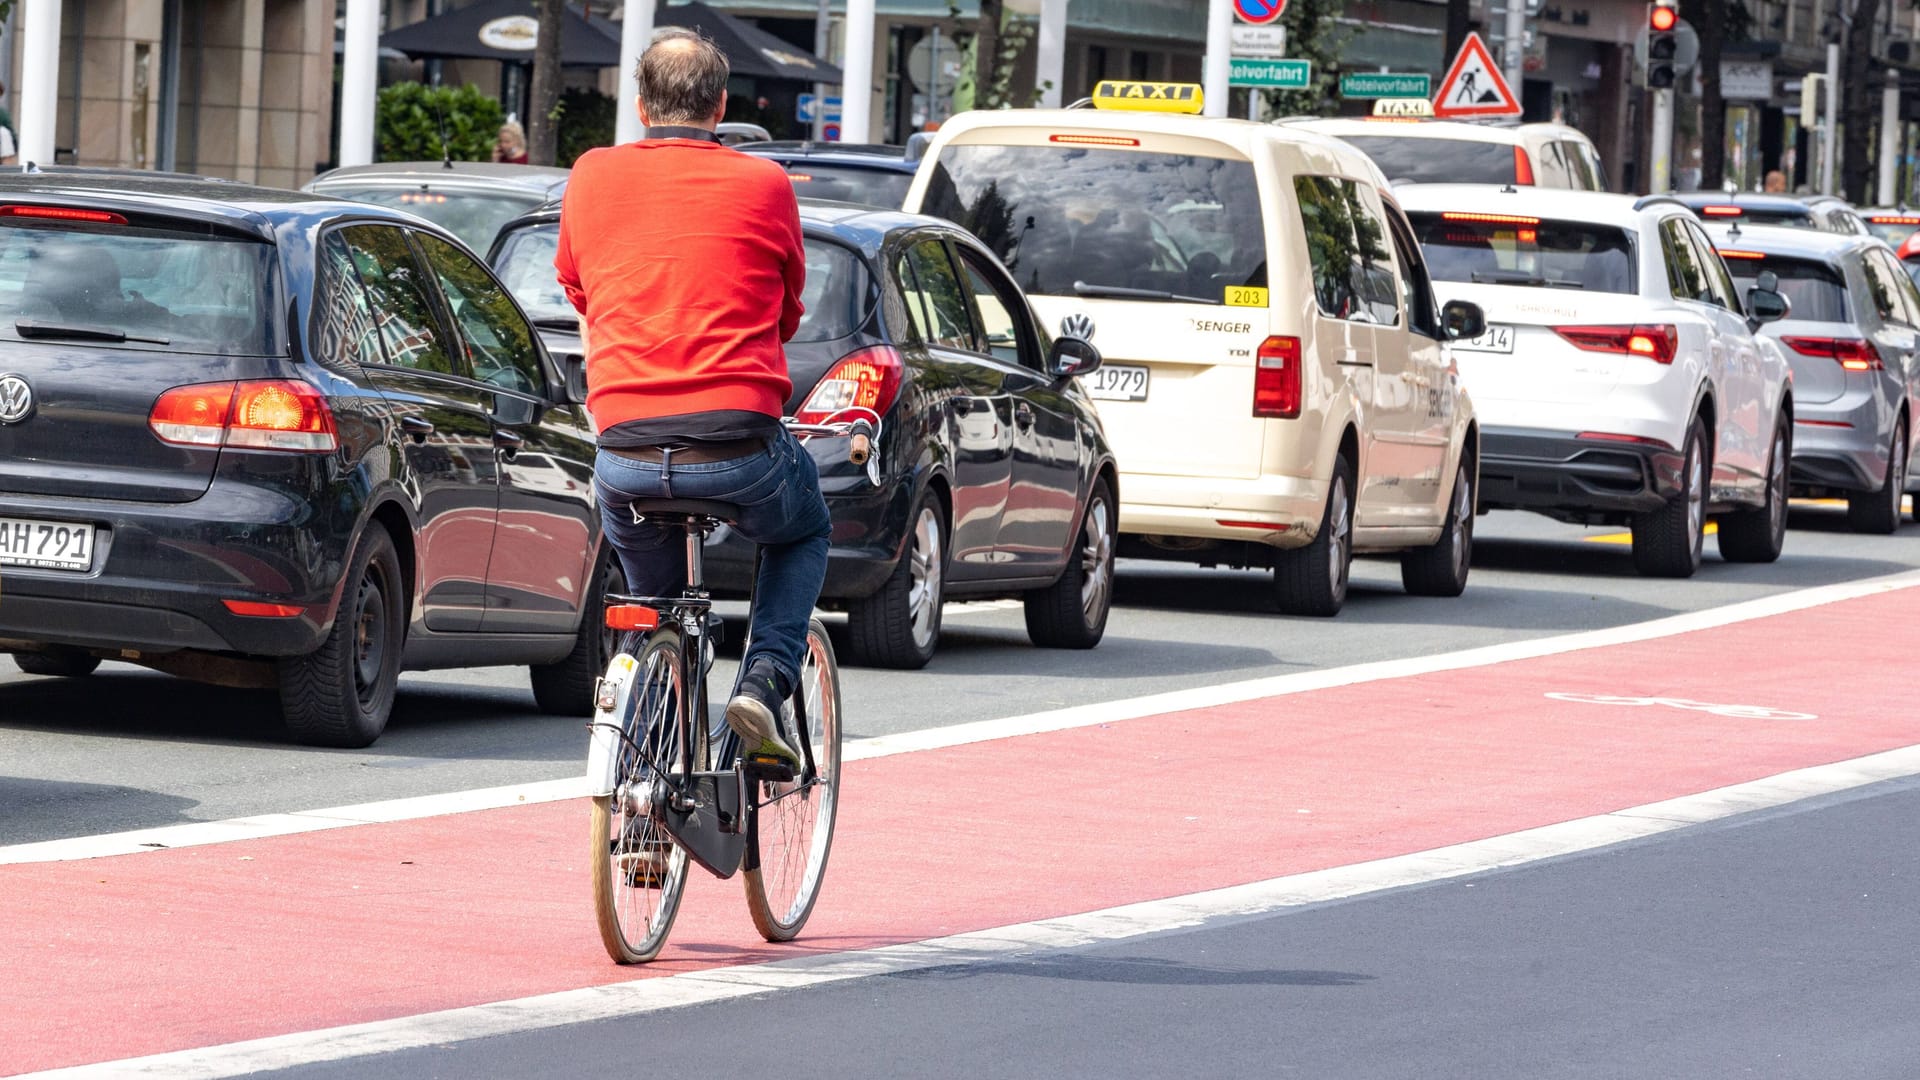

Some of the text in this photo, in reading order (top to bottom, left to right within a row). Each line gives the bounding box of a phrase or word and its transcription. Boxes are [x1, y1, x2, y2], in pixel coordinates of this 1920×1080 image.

[1230, 63, 1303, 81] telvorfahrt
[1111, 83, 1181, 99] TAXI
[1382, 102, 1424, 114] TAXI
[1234, 290, 1259, 304] 203
[1196, 320, 1251, 333] SENGER
[1486, 328, 1508, 348] 14
[1229, 349, 1250, 357] TDI
[1094, 368, 1145, 392] 1979
[37, 525, 86, 558] 791
